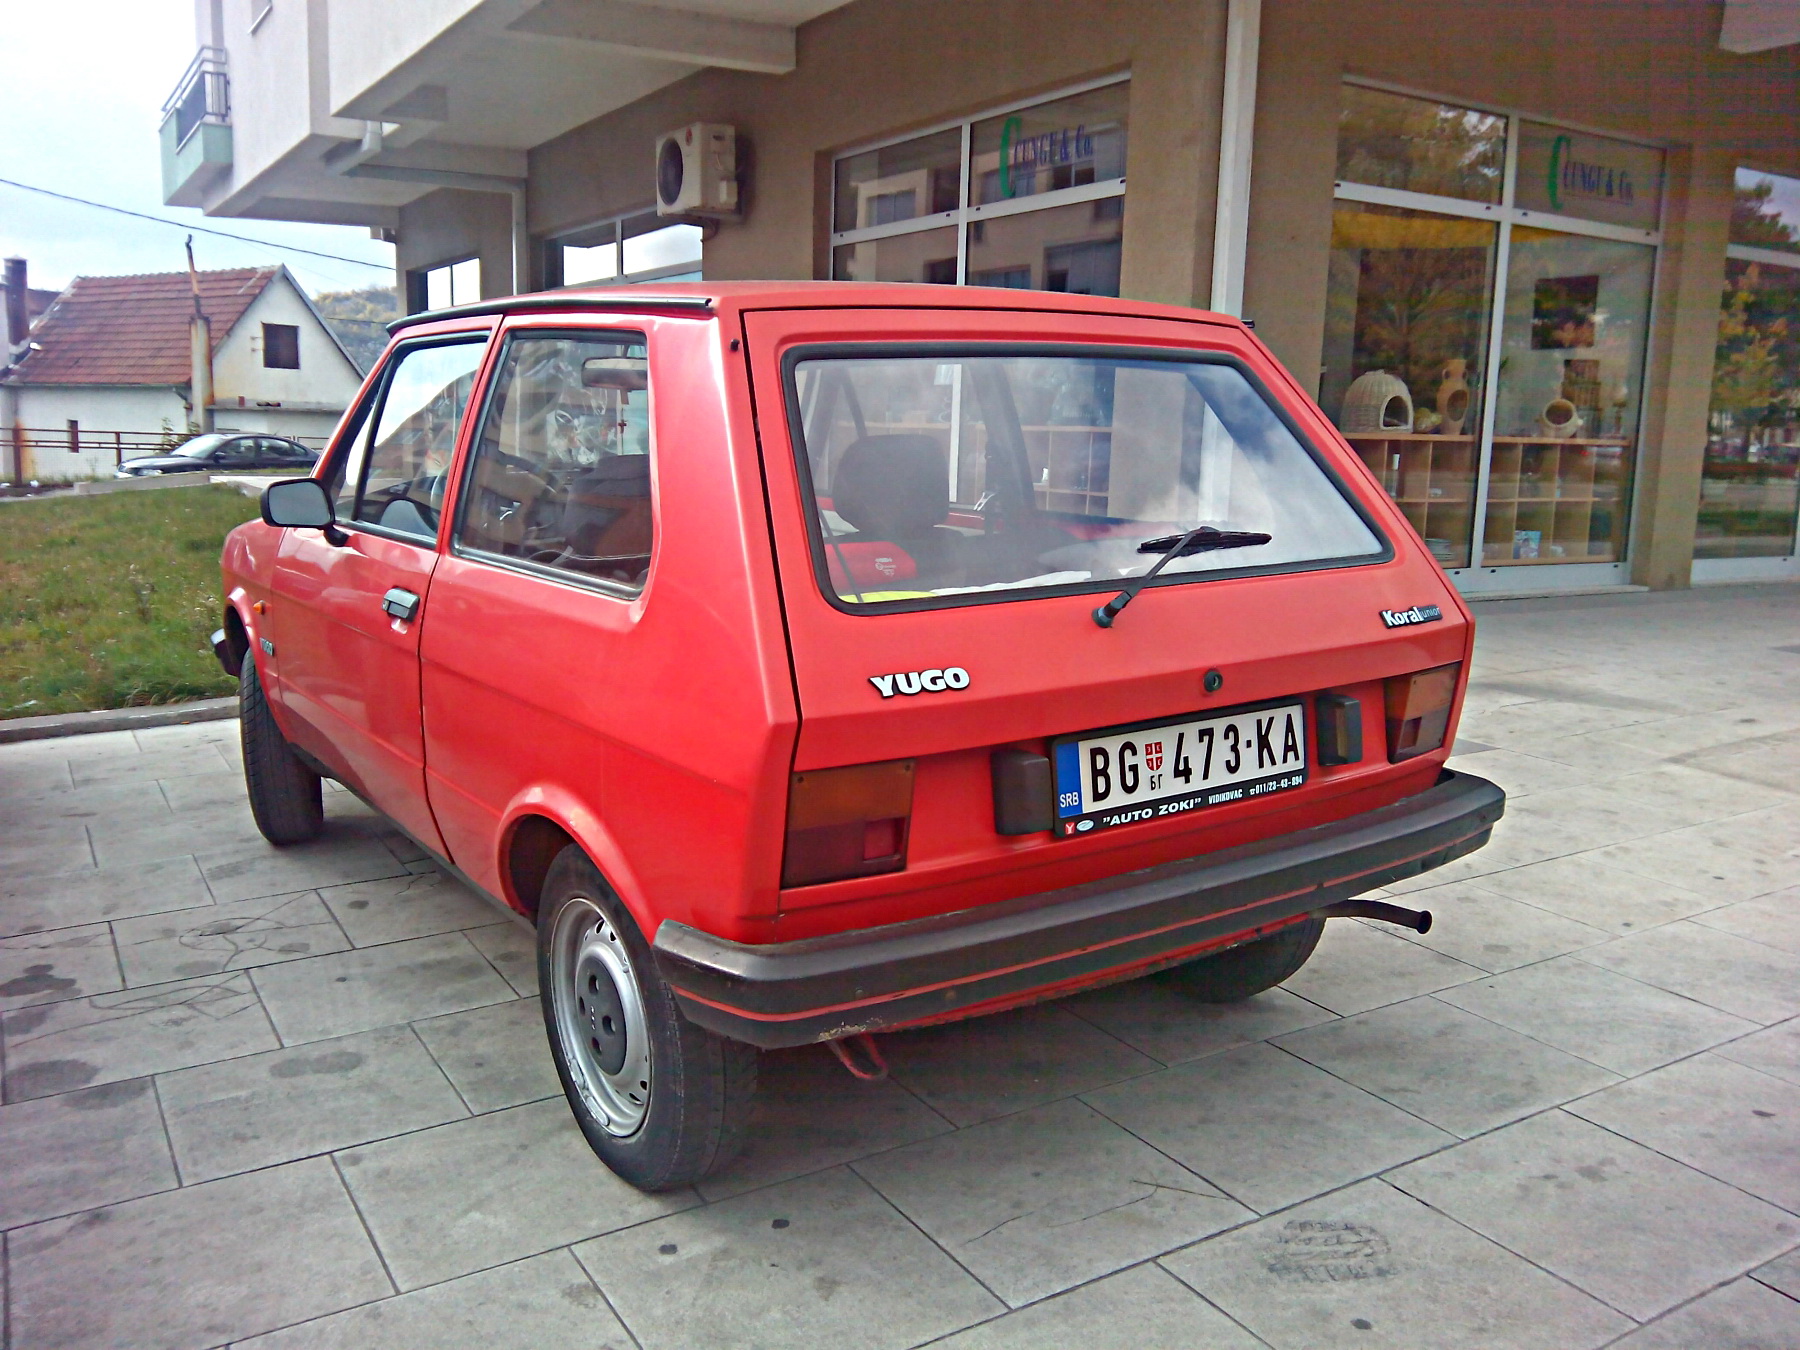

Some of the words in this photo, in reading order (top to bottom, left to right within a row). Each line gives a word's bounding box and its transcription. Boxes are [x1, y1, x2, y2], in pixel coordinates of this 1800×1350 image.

[1382, 606, 1424, 626] Koral
[869, 666, 970, 697] YUGO
[1090, 740, 1140, 802] BG
[1059, 791, 1079, 808] SRB
[1208, 788, 1243, 804] VIDIKOVAC
